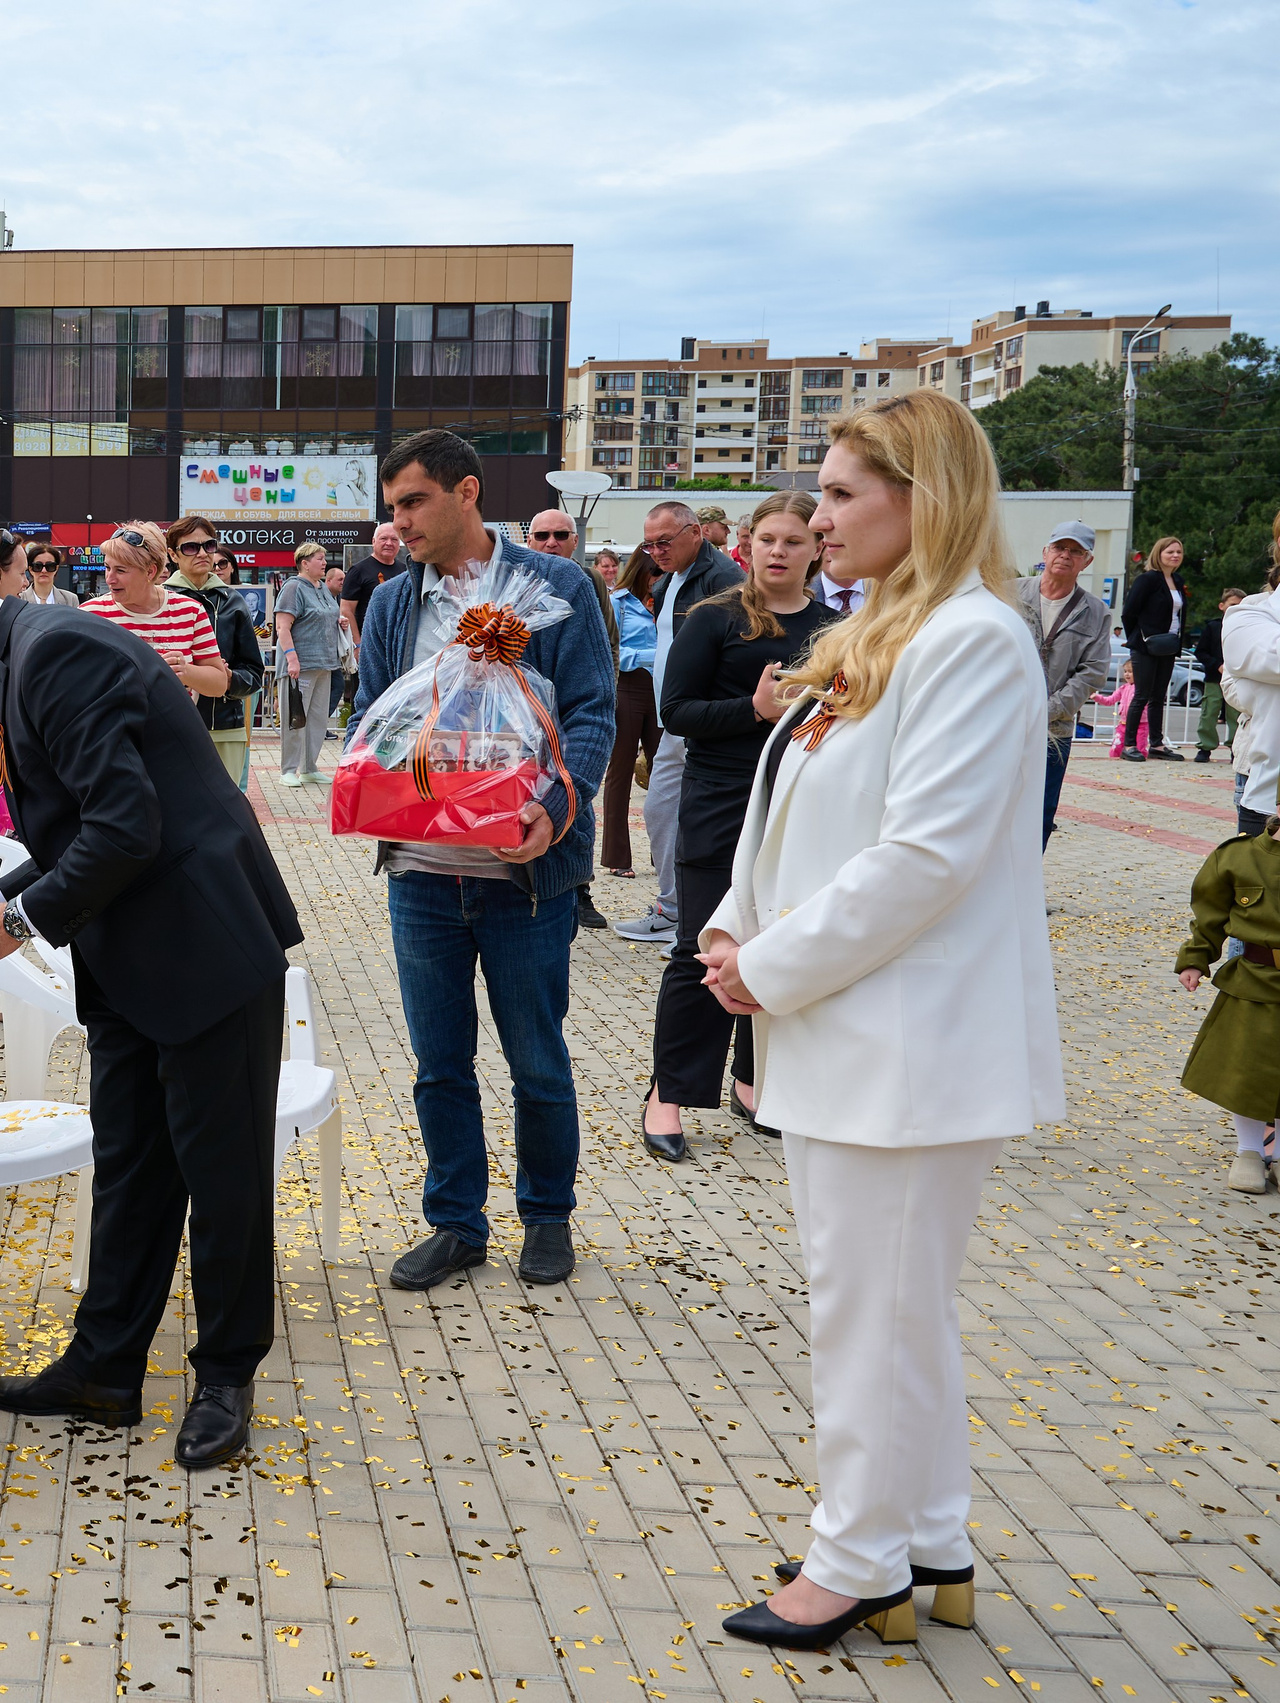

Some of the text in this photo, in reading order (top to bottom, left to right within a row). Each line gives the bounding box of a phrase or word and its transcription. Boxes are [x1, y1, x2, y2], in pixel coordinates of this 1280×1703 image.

[14, 441, 122, 451] 8(928) 22-11 999
[190, 509, 361, 520] ОДЕЖДА И ОБУВЬ ДЛЯ ВСЕЙ СЕМЬИ
[305, 529, 318, 537] От
